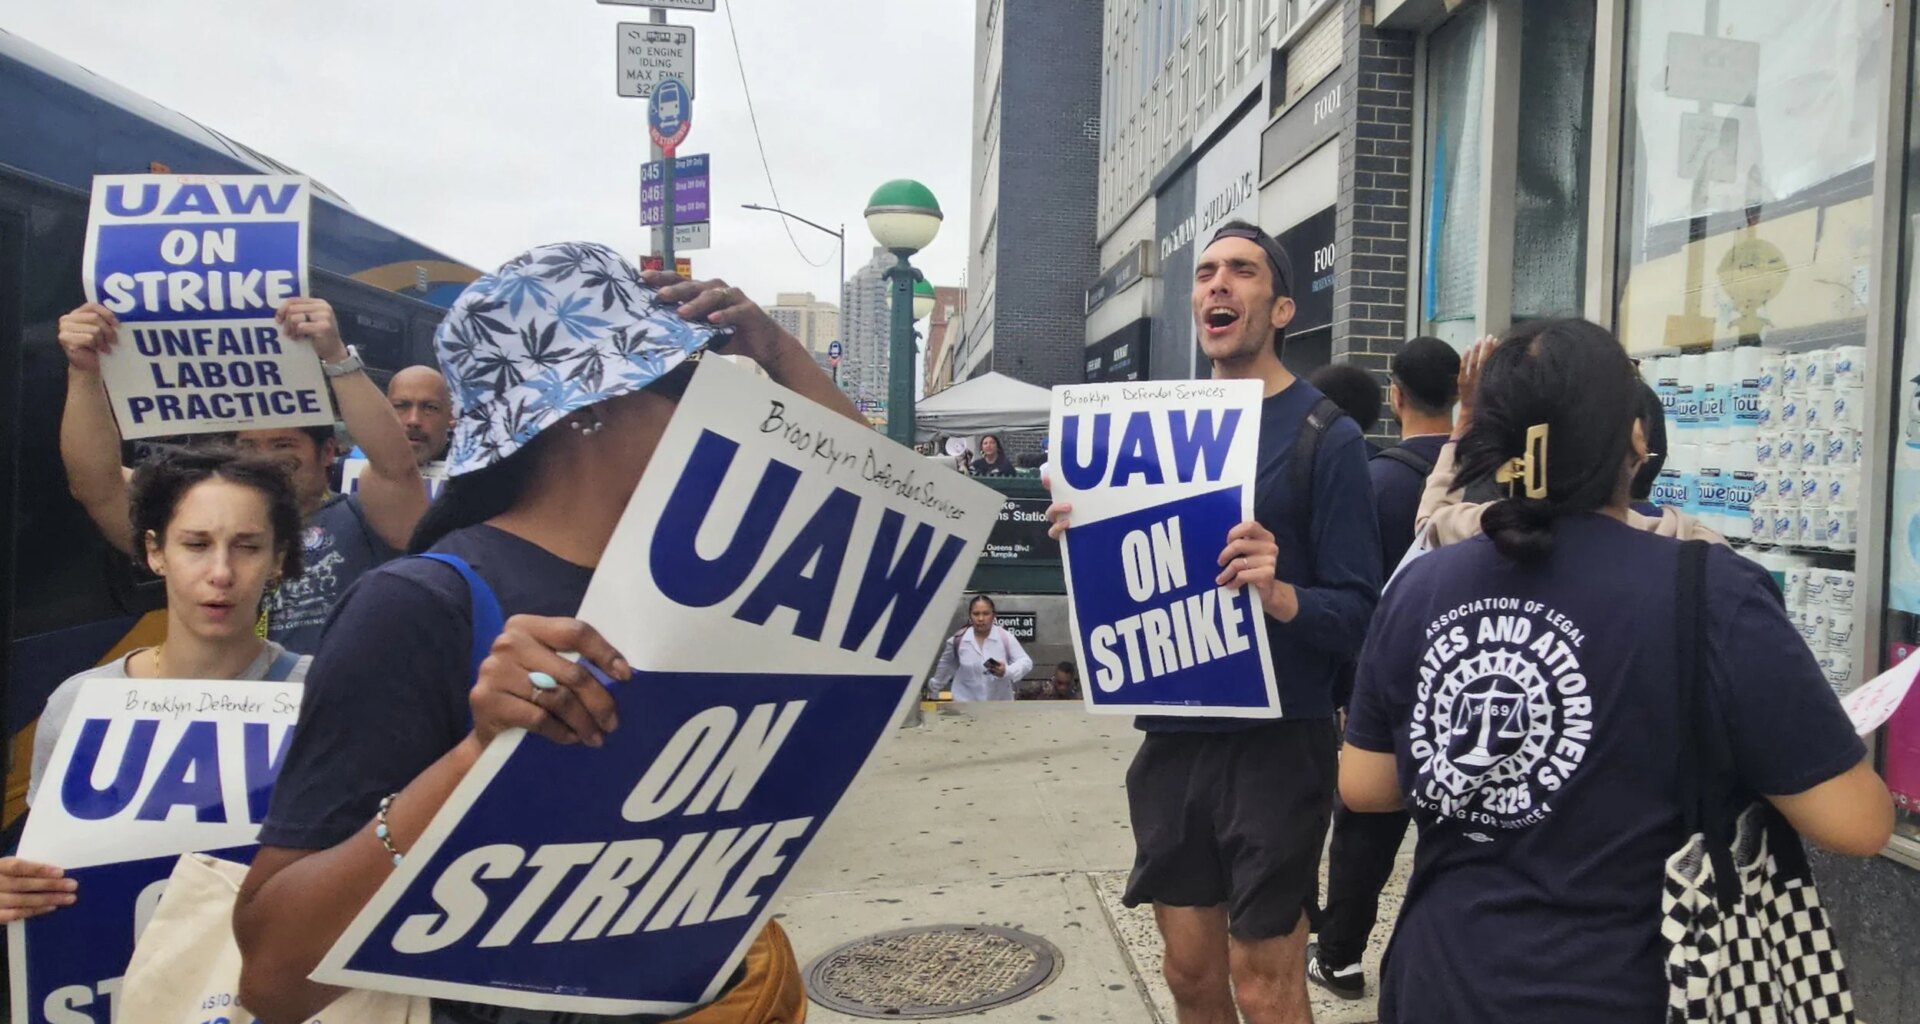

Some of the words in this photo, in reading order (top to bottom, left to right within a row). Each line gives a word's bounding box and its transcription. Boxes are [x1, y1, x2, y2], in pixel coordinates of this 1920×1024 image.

[628, 46, 642, 55] NO
[648, 48, 683, 57] ENGINE
[640, 58, 672, 68] IDLING
[627, 70, 652, 80] MAX
[641, 163, 659, 181] Q45
[105, 184, 301, 217] UAW
[641, 185, 660, 203] Q46
[1202, 170, 1252, 232] BUILDING
[641, 206, 659, 224] Q48
[160, 228, 236, 265] ON
[102, 268, 294, 314] STRIKE
[132, 327, 282, 357] UNFAIR
[149, 360, 282, 389] LABOR
[127, 389, 321, 424] PRACTICE
[1063, 389, 1110, 407] Brooklyn
[1175, 383, 1227, 399] Services
[760, 400, 857, 474] Brooklyn
[1060, 408, 1243, 490] UAW
[648, 428, 968, 662] UAW
[1120, 515, 1188, 603] ON
[993, 617, 1020, 628] Agent
[1023, 617, 1033, 626] at
[1426, 597, 1520, 640] ASSOCIATION
[1524, 600, 1545, 614] OF
[1545, 608, 1585, 648] LEGAL
[1090, 587, 1250, 693] STRIKE
[125, 689, 191, 720] Brooklyn
[196, 691, 264, 713] Defender
[1477, 615, 1532, 644] AND
[1529, 631, 1593, 792] ATTORNEYS
[621, 699, 808, 823] ON
[1480, 782, 1532, 814] 2325
[391, 815, 814, 954] STRIKE
